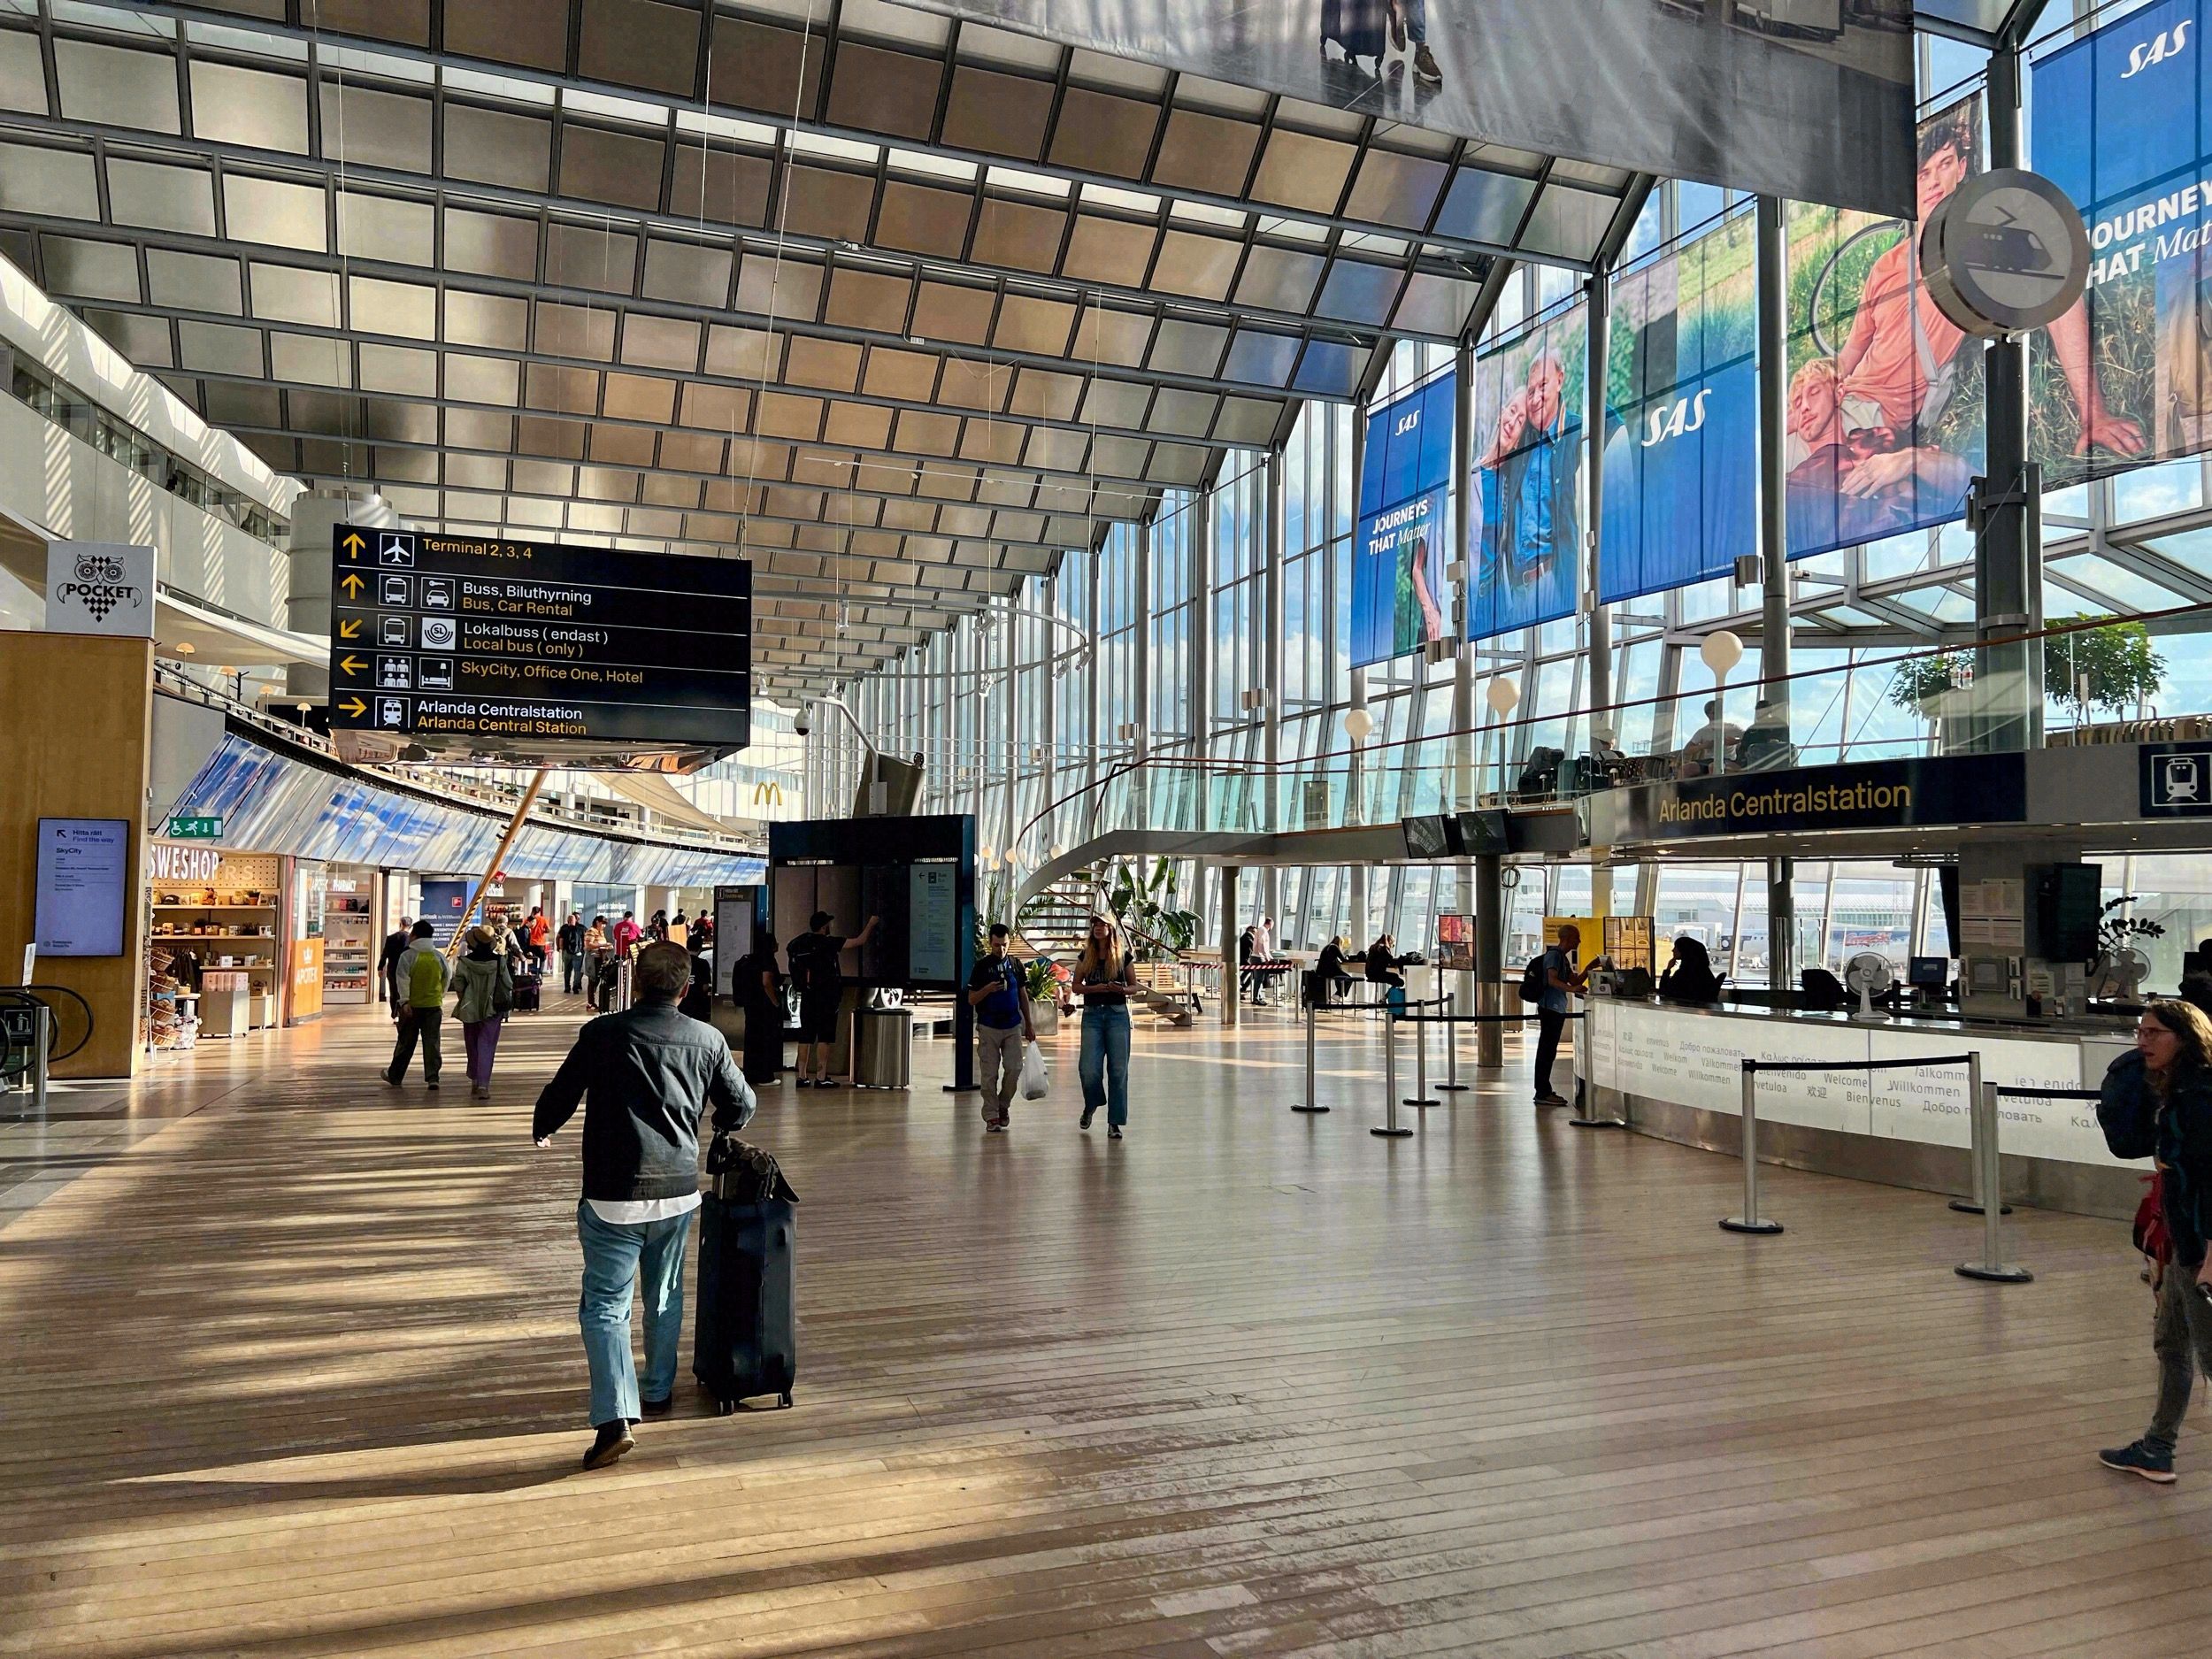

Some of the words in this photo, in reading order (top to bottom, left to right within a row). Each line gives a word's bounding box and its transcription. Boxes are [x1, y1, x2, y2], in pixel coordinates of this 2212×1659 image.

[2120, 19, 2193, 79] SAS
[2085, 180, 2212, 250] OURNEY
[2086, 242, 2146, 290] HAT
[1395, 410, 1420, 436] SAS
[1641, 388, 1712, 447] SAS
[1372, 499, 1428, 534] JOURNEYS
[423, 538, 486, 556] Terminal
[490, 545, 503, 558] 2,
[506, 546, 519, 560] 3,
[523, 547, 533, 558] 4
[1369, 533, 1396, 556] THAT
[1397, 522, 1431, 547] Matter
[66, 583, 134, 599] POCKET
[463, 581, 503, 598] Buss,
[506, 585, 592, 606] Biluthyrning
[462, 597, 494, 612] Bus,
[497, 600, 524, 613] Car
[526, 602, 572, 617] Rental
[465, 622, 539, 639] Lokalbuss
[464, 637, 503, 652] Local
[507, 639, 534, 652] bus
[461, 661, 520, 679] SkyCity,
[524, 665, 567, 680] Office
[571, 668, 603, 682] One,
[606, 670, 643, 684] Hotel
[418, 700, 476, 716] Arlanda
[479, 703, 582, 720] Centralstation
[418, 716, 475, 731] Arlanda
[479, 718, 533, 733] Central
[535, 721, 587, 735] Station
[1659, 793, 1725, 823] Arlanda
[1730, 780, 1911, 818] Centralstation
[56, 847, 82, 856] SkyCity
[150, 844, 219, 881] SWESHOP
[296, 966, 319, 985] APOTEK
[1824, 1072, 1869, 1089] Welcome
[1807, 1086, 1827, 1099] 欢迎
[1847, 1090, 1901, 1108] Bienvenus
[1923, 1100, 1961, 1115] Добро
